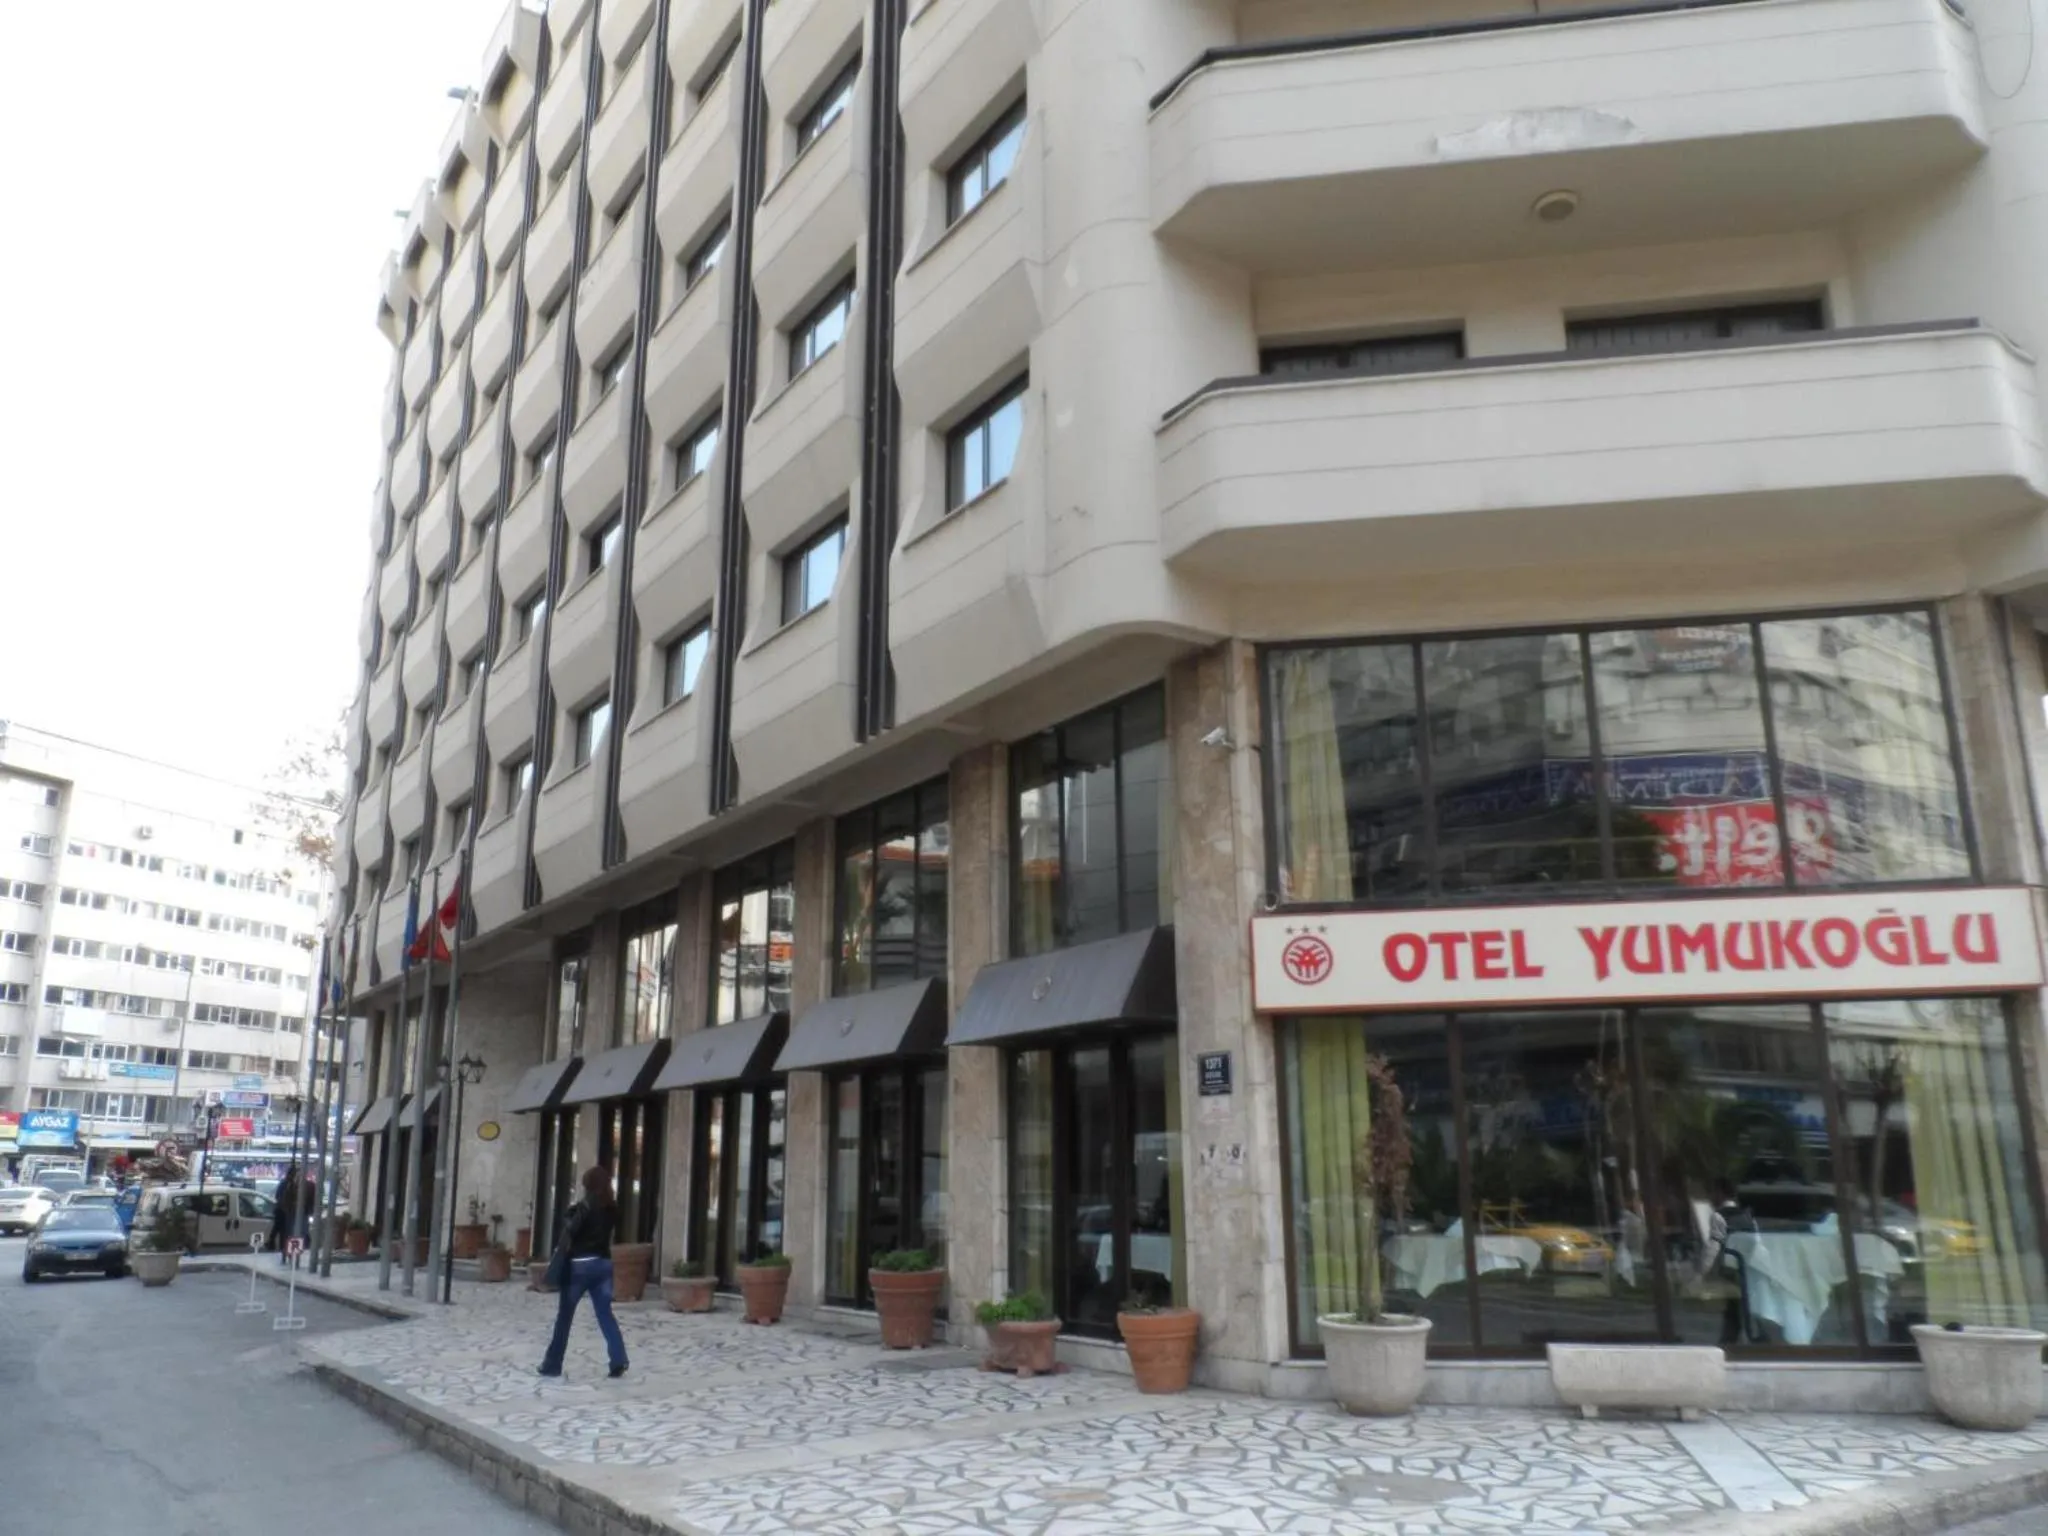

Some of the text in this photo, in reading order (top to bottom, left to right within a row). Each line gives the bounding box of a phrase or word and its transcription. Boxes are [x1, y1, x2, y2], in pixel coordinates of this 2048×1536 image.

[1382, 907, 2000, 983] OTEL YUMUKOĞLU
[31, 1115, 70, 1128] AYGAZ
